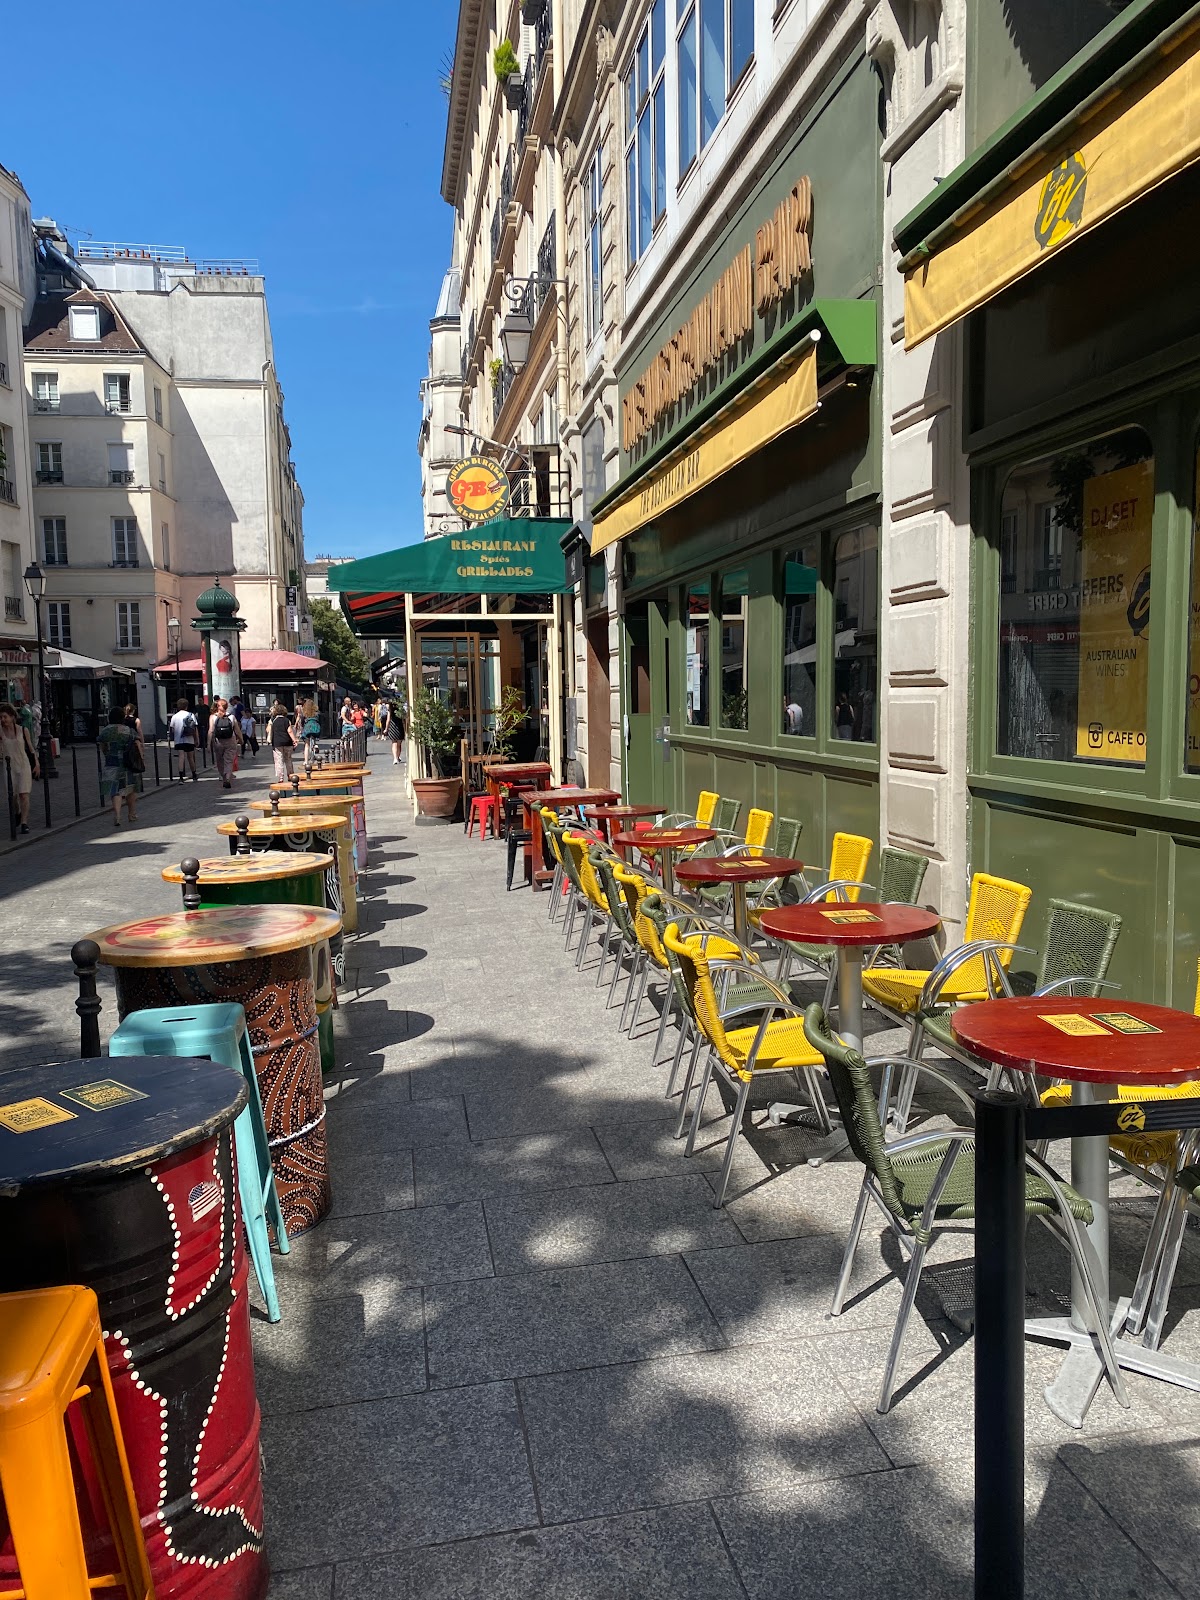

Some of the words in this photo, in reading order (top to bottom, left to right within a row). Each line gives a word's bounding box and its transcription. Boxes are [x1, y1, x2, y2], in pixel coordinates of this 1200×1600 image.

[470, 456, 505, 480] BURGER
[687, 450, 700, 485] BAR
[456, 498, 506, 521] RESTAURANT
[1091, 506, 1110, 527] DJ
[1112, 497, 1139, 521] SET
[451, 539, 537, 552] RESTAURANT
[456, 566, 534, 577] GRILLADES
[1083, 573, 1124, 598] BEERS
[1086, 648, 1137, 662] AUSTRALIAN
[1095, 662, 1126, 678] WINES
[1107, 730, 1133, 745] CAFE
[1136, 732, 1146, 746] O
